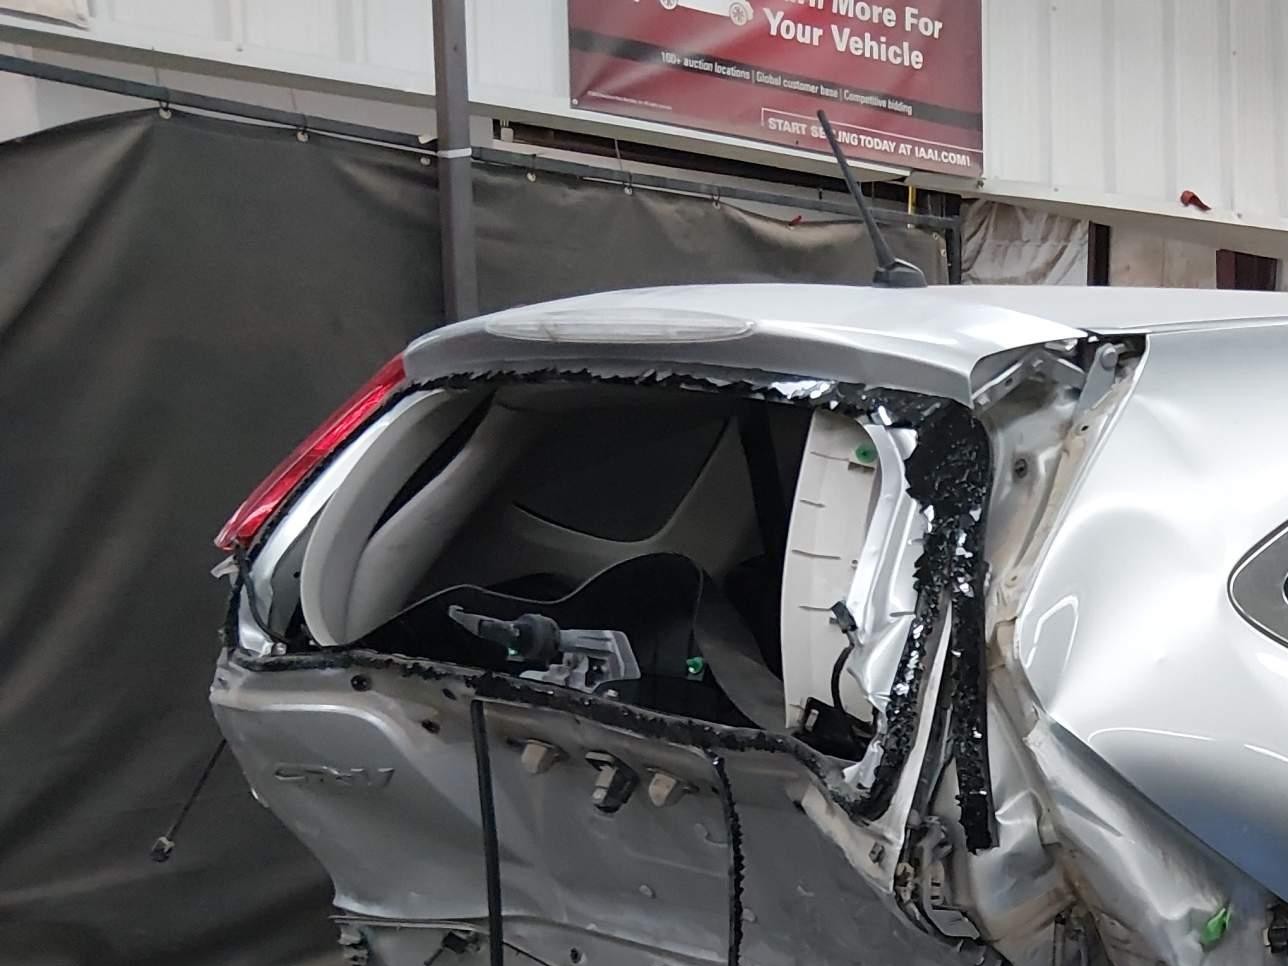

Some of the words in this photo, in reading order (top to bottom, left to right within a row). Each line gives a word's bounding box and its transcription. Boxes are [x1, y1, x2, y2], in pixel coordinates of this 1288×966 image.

[763, 7, 823, 46] Your
[831, 24, 924, 69] Vehicle
[832, 0, 897, 27] More
[904, 6, 943, 38] For
[683, 57, 713, 72] auction
[714, 61, 751, 79] locations
[756, 71, 782, 86] Global
[768, 117, 808, 136] START
[810, 125, 858, 146] SEING
[858, 134, 897, 153] TODAY
[898, 143, 913, 156] AT
